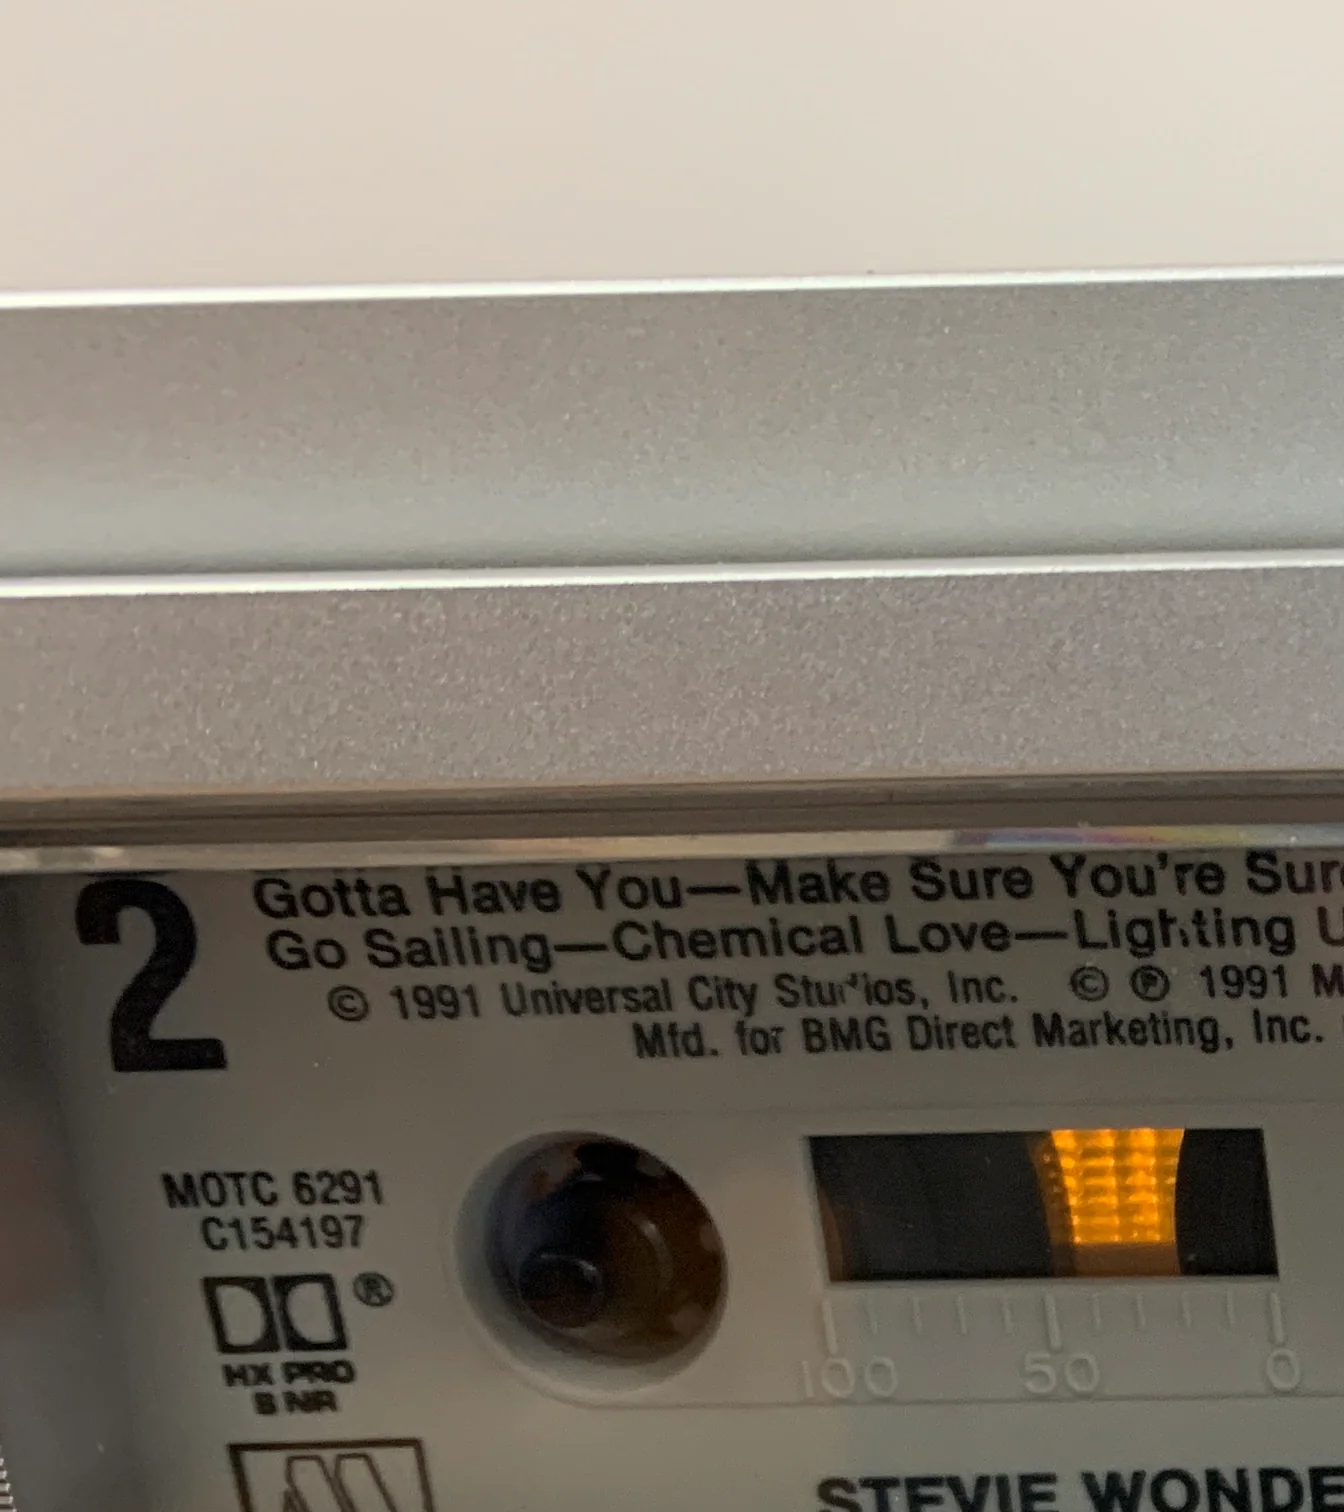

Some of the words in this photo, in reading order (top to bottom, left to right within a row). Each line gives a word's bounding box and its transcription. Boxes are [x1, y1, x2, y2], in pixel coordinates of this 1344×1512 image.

[252, 873, 413, 920] Gotta
[425, 871, 562, 917] Have
[908, 853, 1034, 904] Sure
[1048, 851, 1227, 900] You're
[266, 927, 348, 972] Go
[74, 877, 228, 1074] 2
[389, 984, 481, 1021] 1991
[500, 976, 673, 1018] Universal
[687, 972, 758, 1019] City
[946, 969, 1019, 1006] Inc.
[1199, 963, 1290, 1000] 1991
[632, 1019, 719, 1060] Mfd.
[736, 1019, 785, 1057] for
[801, 1014, 893, 1055] BMG
[906, 1010, 1018, 1052] Direct
[1031, 1008, 1235, 1056] Marketing,
[1253, 1006, 1324, 1046] Inc.
[161, 1171, 277, 1209] MOTC
[293, 1170, 385, 1205] 6291
[202, 1214, 366, 1251] C154197
[221, 1363, 276, 1387] HX
[283, 1360, 356, 1384] PRO
[1024, 1352, 1099, 1394] 50
